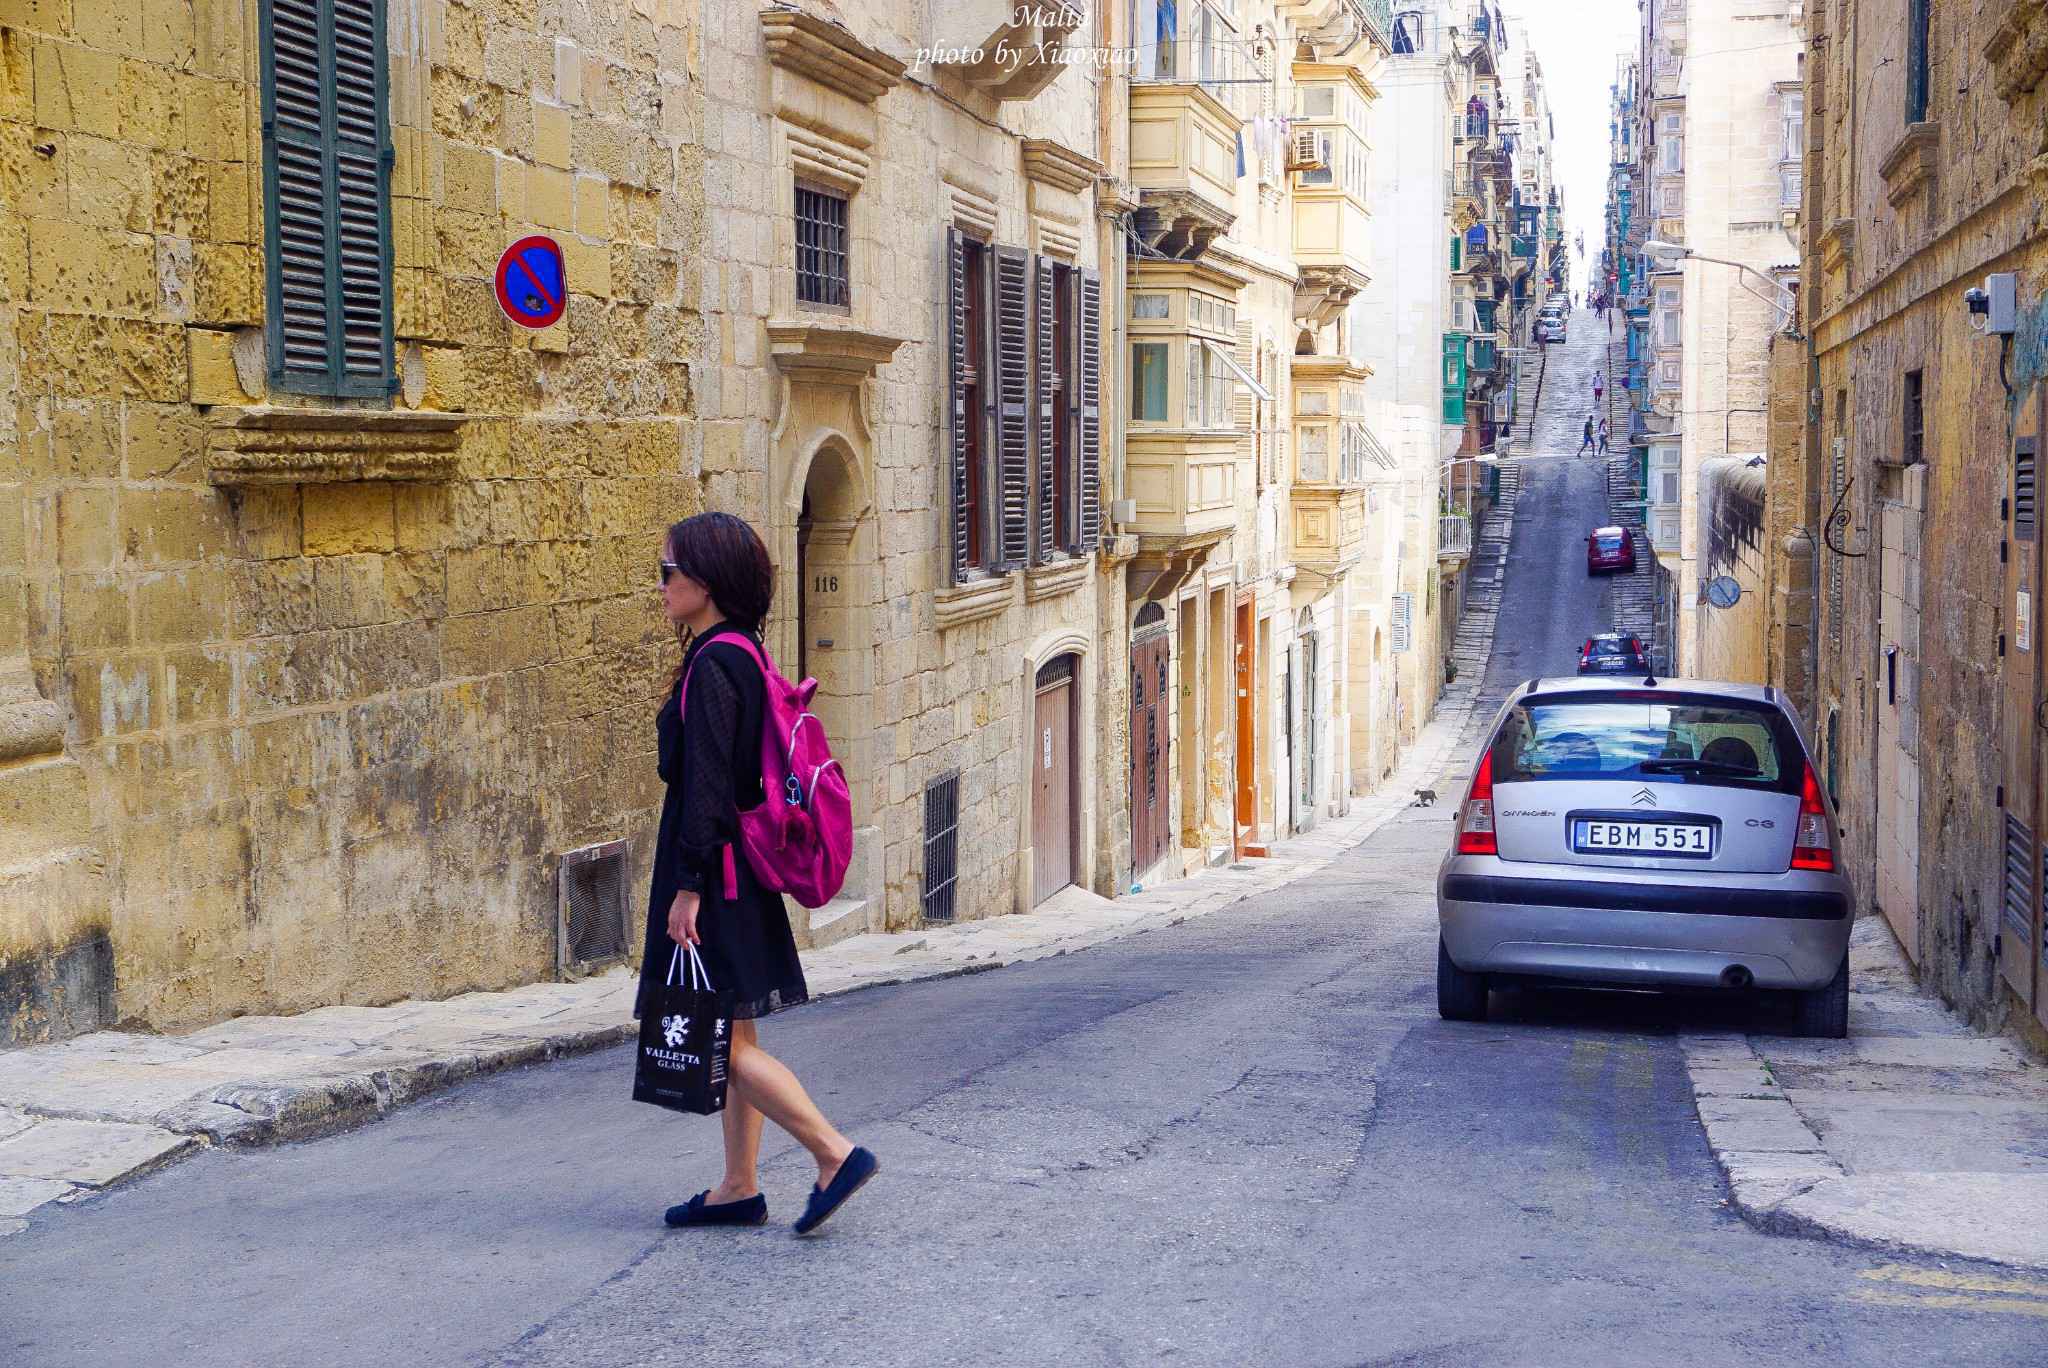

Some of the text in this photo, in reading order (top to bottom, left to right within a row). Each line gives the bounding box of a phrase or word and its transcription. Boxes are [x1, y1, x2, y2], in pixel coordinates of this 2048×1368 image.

[815, 576, 838, 592] 116
[1744, 818, 1775, 829] C3
[1590, 825, 1705, 850] EBM 551
[645, 1047, 700, 1065] VALLETTA
[657, 1059, 686, 1071] GLASS
